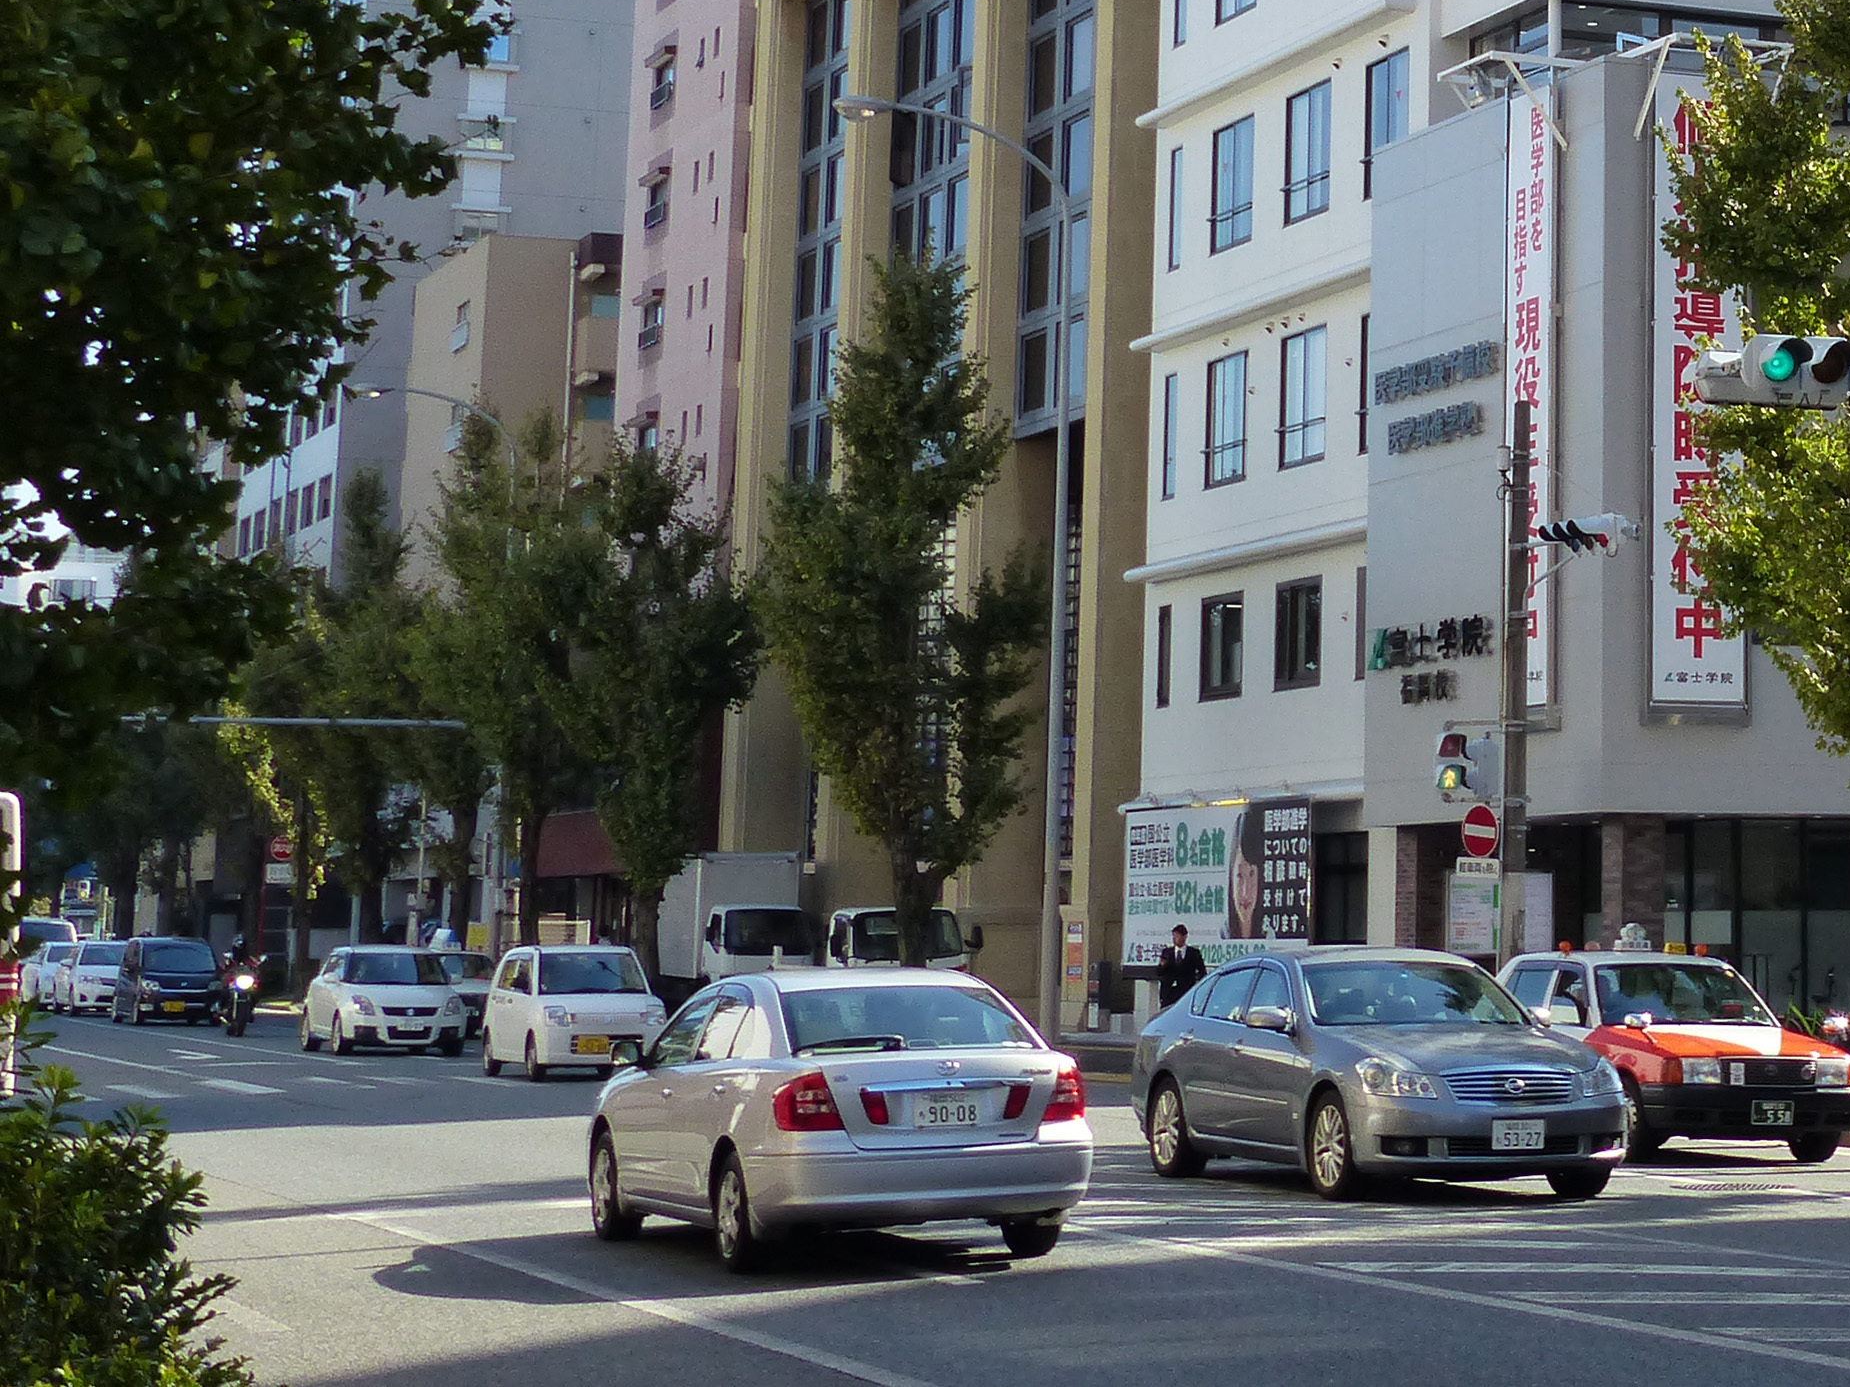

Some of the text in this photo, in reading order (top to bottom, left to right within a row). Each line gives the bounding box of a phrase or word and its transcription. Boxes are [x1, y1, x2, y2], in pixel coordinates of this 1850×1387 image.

[1513, 188, 1528, 297] 目指す
[1676, 672, 1733, 685] 富士学院
[1264, 838, 1308, 856] についての
[929, 1104, 976, 1123] 90-08
[1504, 1131, 1541, 1147] 53-27
